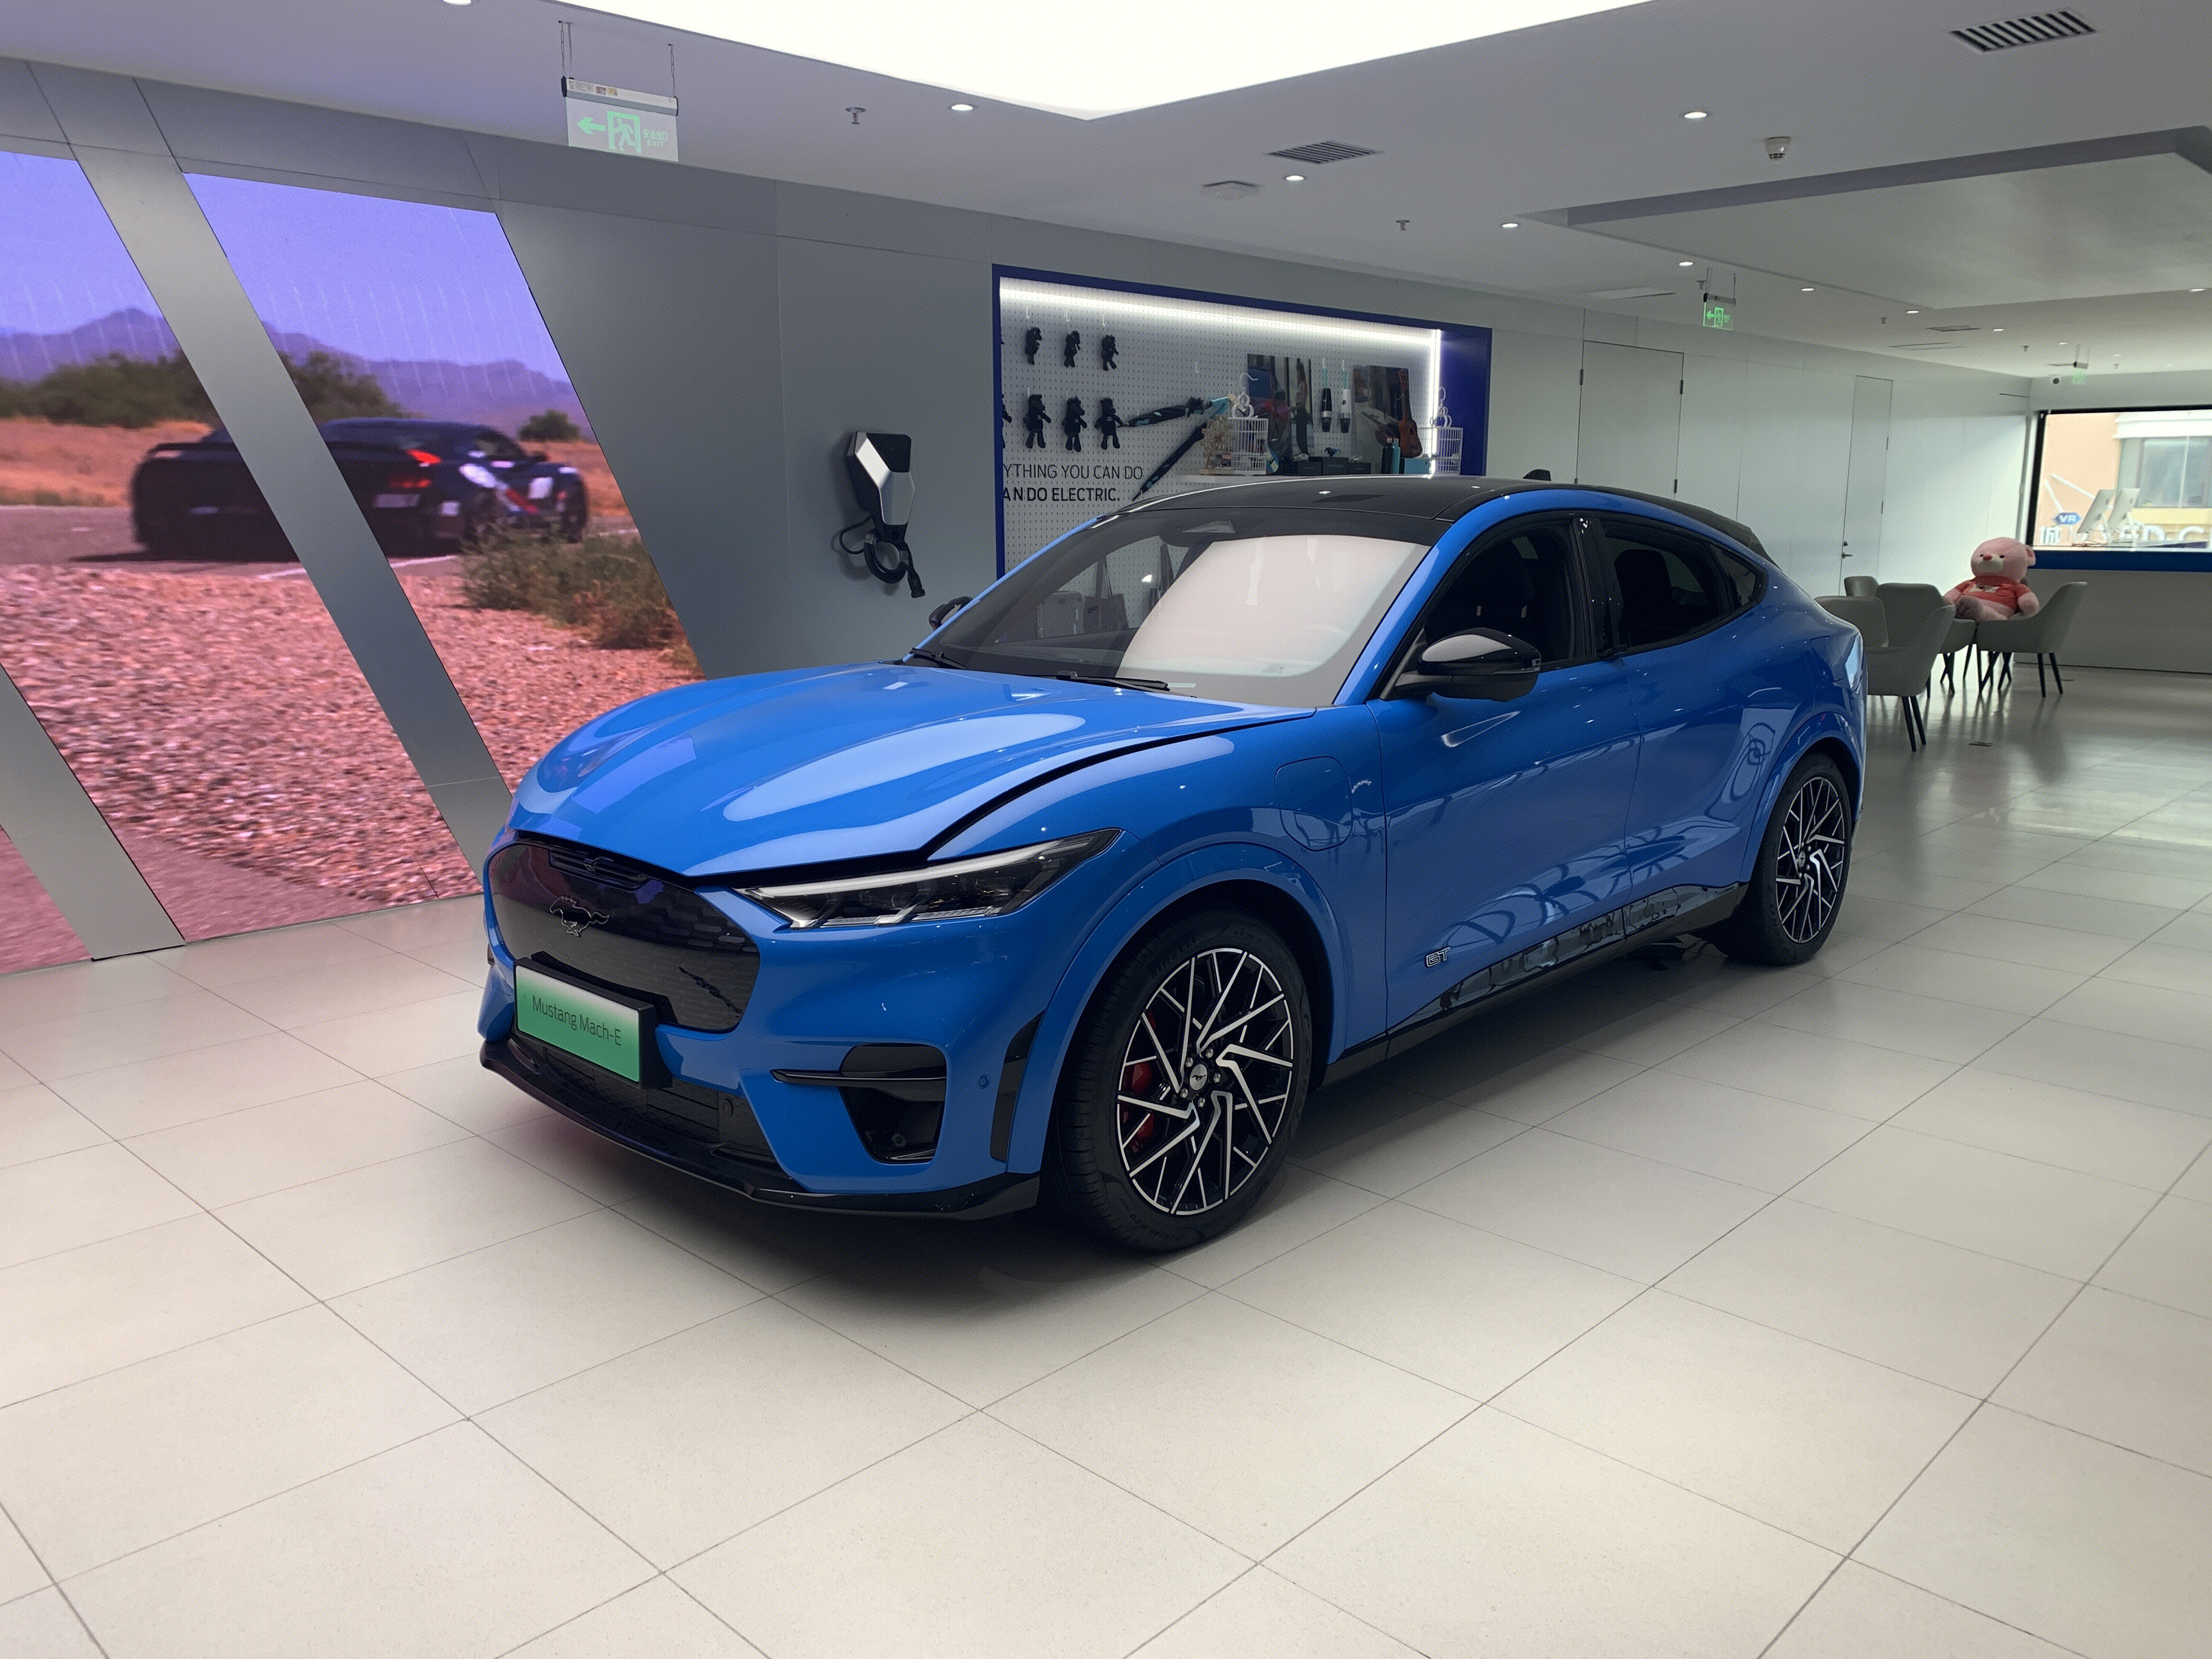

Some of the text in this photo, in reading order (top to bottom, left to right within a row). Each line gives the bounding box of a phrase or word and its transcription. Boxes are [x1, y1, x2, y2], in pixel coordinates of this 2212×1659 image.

[642, 129, 668, 140] 安全出口
[647, 139, 664, 148] EXIT
[1062, 465, 1089, 479] YOU
[1094, 465, 1120, 479] CAN
[1125, 466, 1143, 479] DO
[1027, 487, 1047, 501] DO
[1052, 488, 1120, 501] ELECTRIC.
[2059, 515, 2076, 523] VR
[1426, 947, 1451, 967] GT
[533, 995, 621, 1046] Mustang Mach-E
